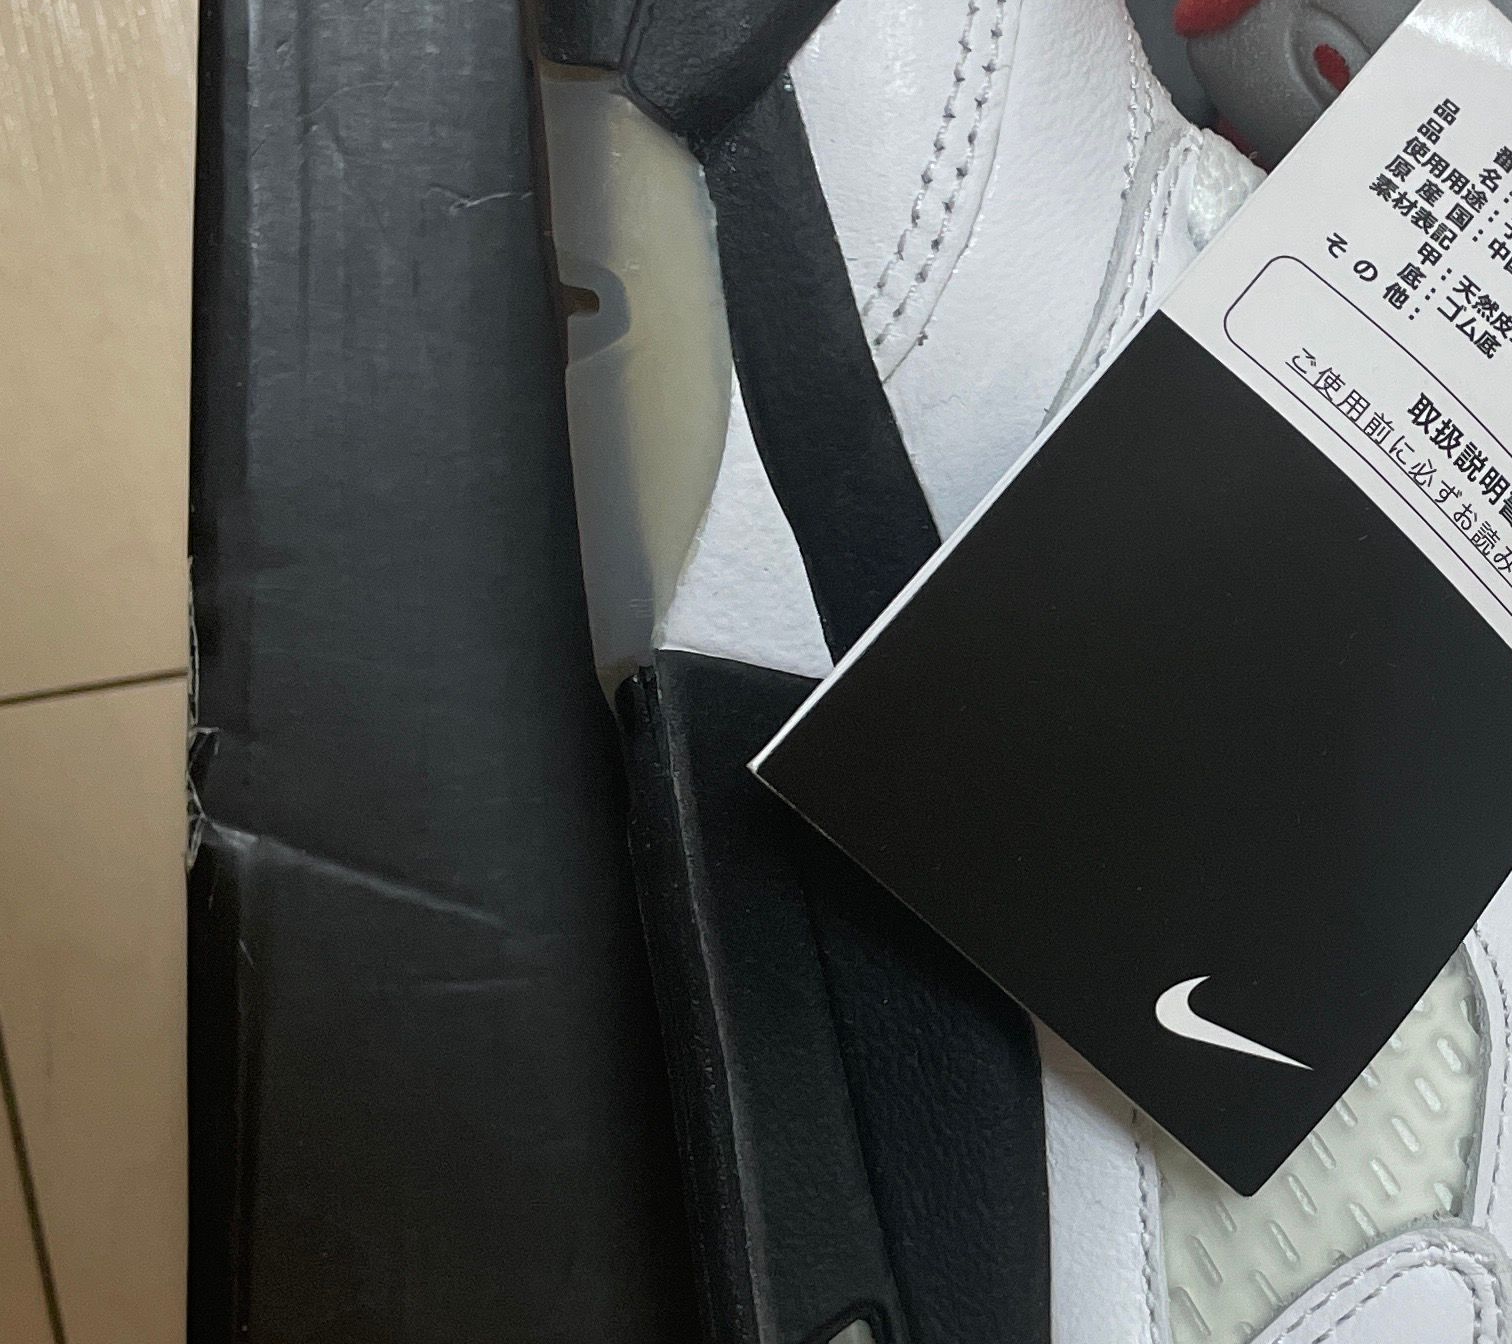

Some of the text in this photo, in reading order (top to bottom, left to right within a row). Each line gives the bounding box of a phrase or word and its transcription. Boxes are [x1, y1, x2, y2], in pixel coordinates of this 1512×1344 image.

[1416, 116, 1445, 145] 品
[1432, 97, 1460, 126] 品
[1368, 172, 1458, 251] 素材表記
[1436, 295, 1502, 359] ゴム底
